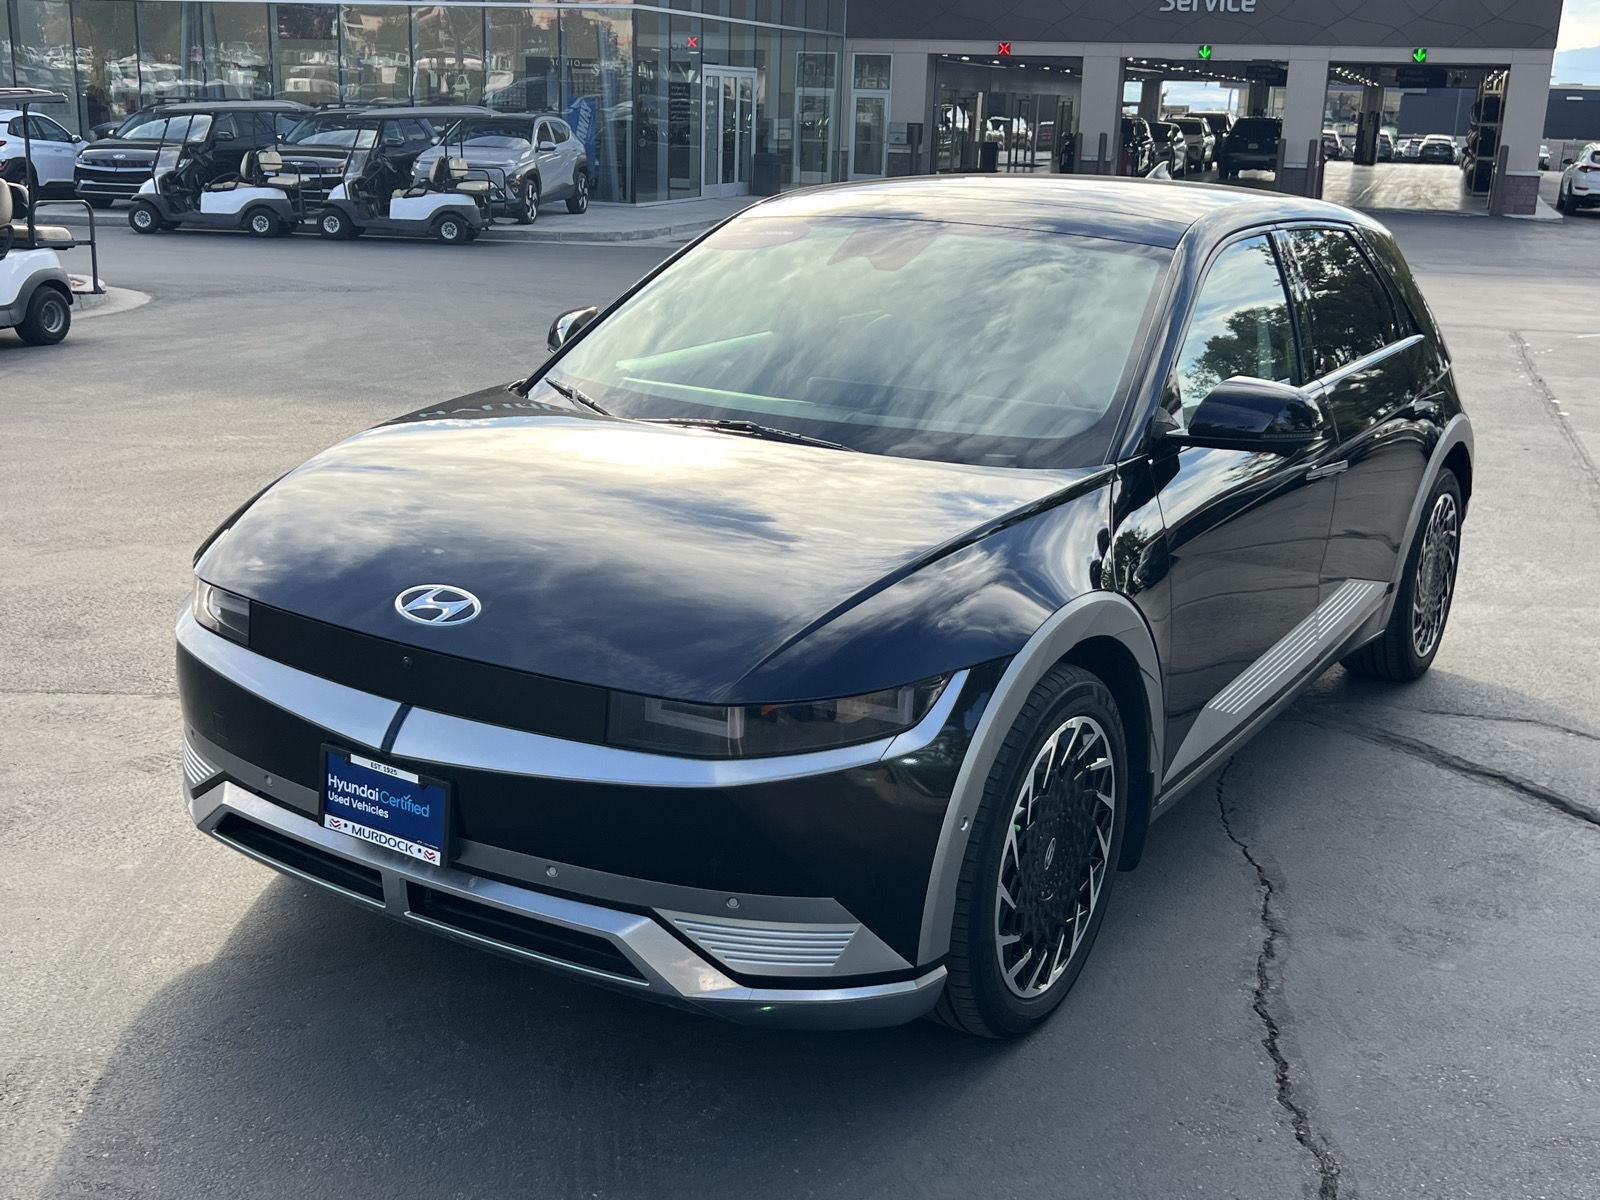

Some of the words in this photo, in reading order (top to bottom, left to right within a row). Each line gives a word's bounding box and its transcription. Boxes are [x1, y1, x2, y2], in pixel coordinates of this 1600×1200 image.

[383, 765, 398, 776] 1925
[328, 773, 379, 802] Hyundai
[380, 790, 430, 818] Certified
[328, 790, 350, 806] Used
[351, 797, 389, 819] Vehicles
[351, 824, 414, 855] MURDOCK
